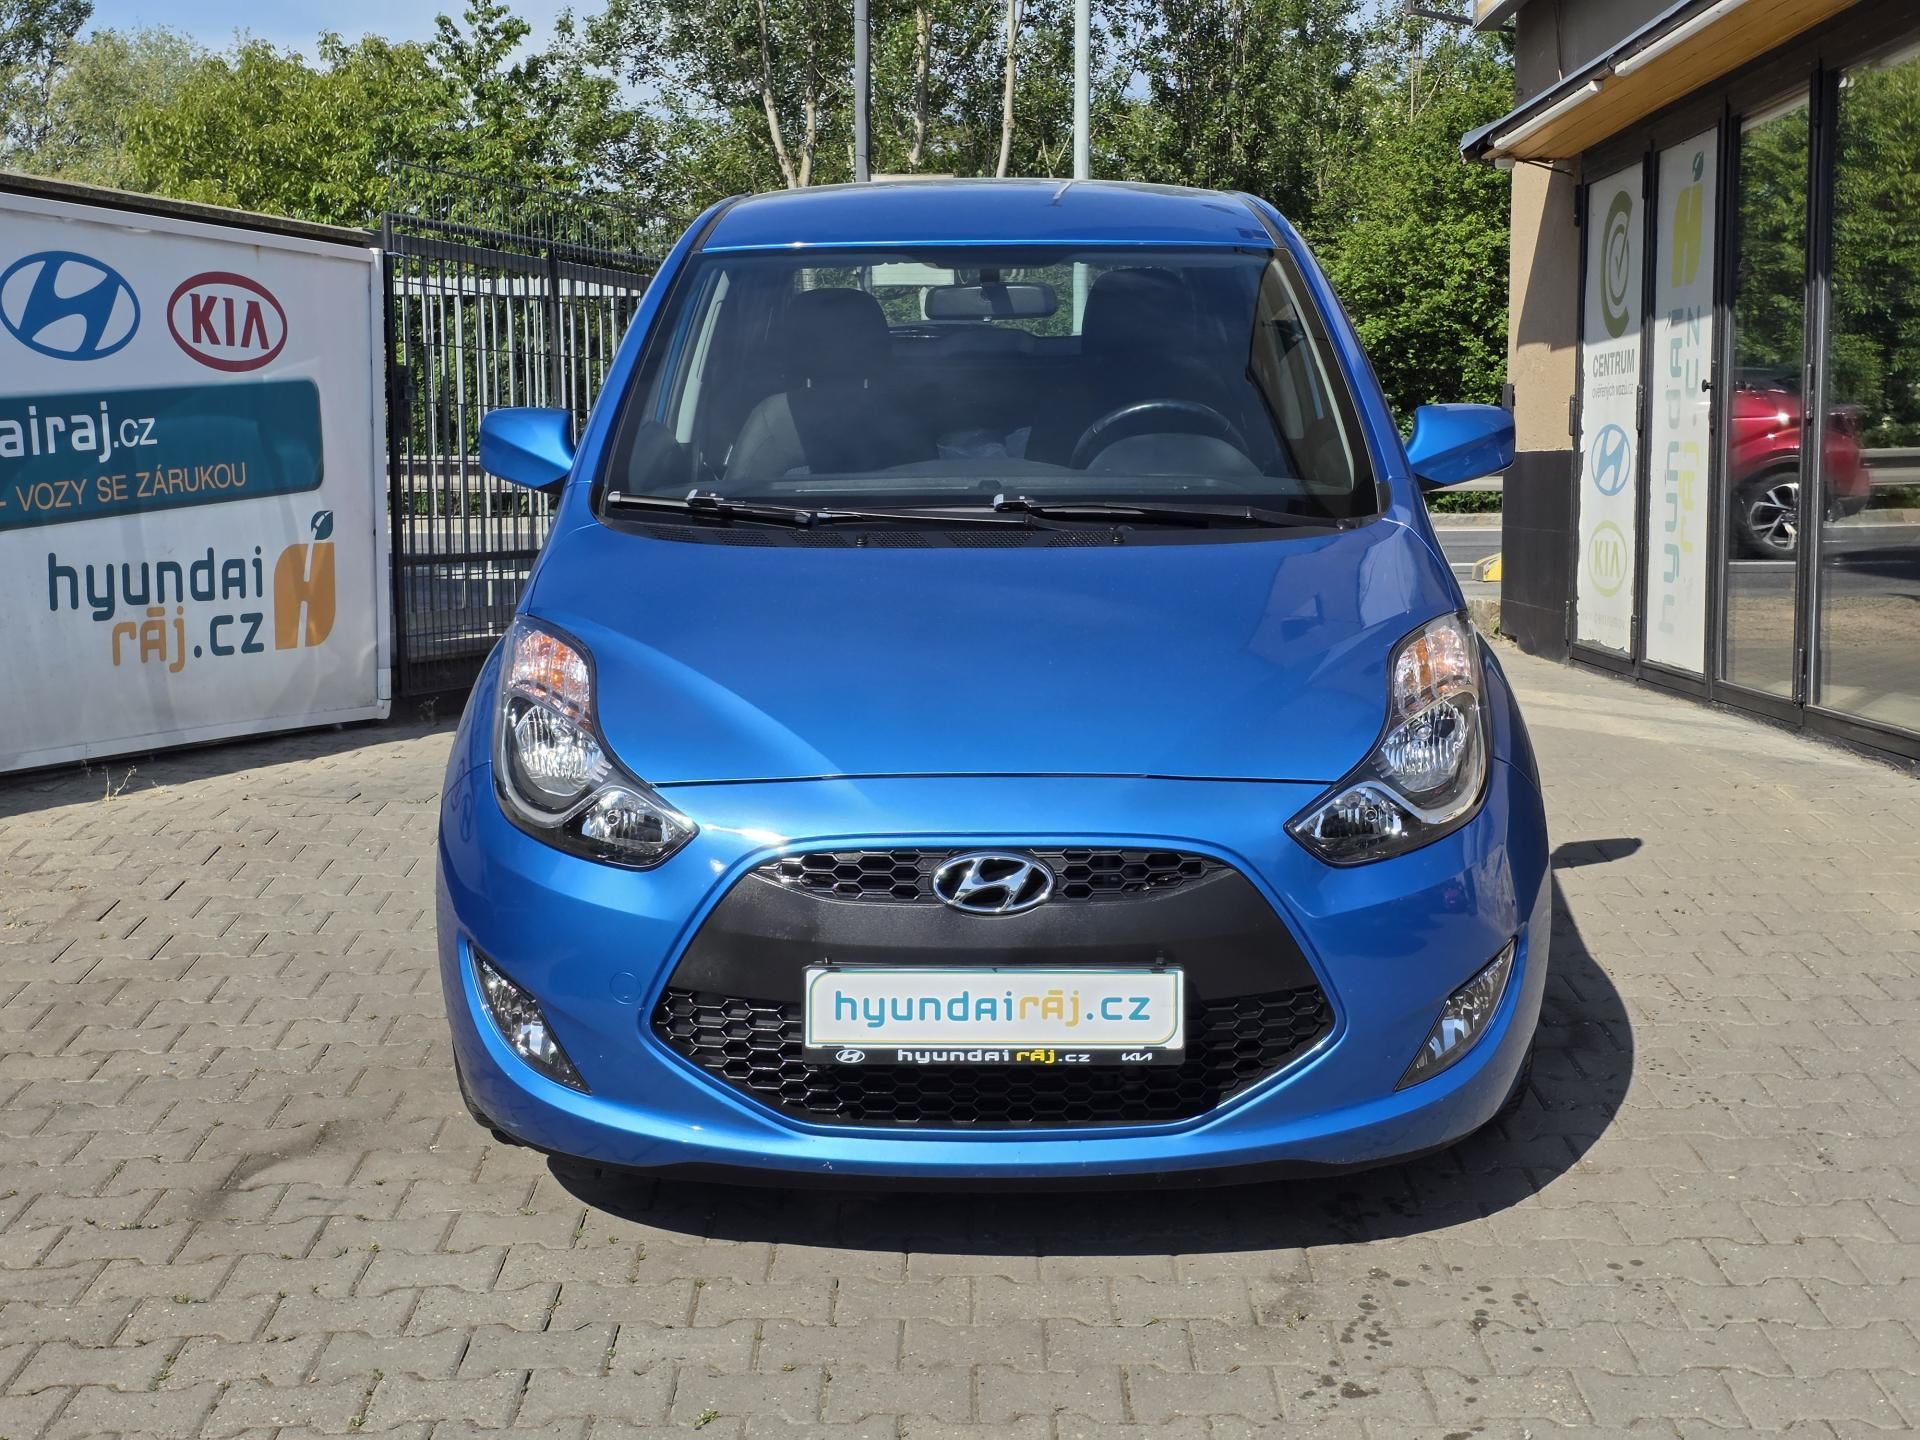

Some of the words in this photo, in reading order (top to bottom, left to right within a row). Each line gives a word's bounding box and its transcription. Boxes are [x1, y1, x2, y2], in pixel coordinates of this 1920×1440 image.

[189, 293, 271, 350] KIA
[1592, 348, 1635, 378] CENTRUM
[16, 478, 87, 512] VOZY
[97, 474, 128, 503] SE
[136, 461, 247, 498] ZÁRUKOU
[48, 545, 263, 622] hyundai
[1593, 539, 1621, 578] KIA
